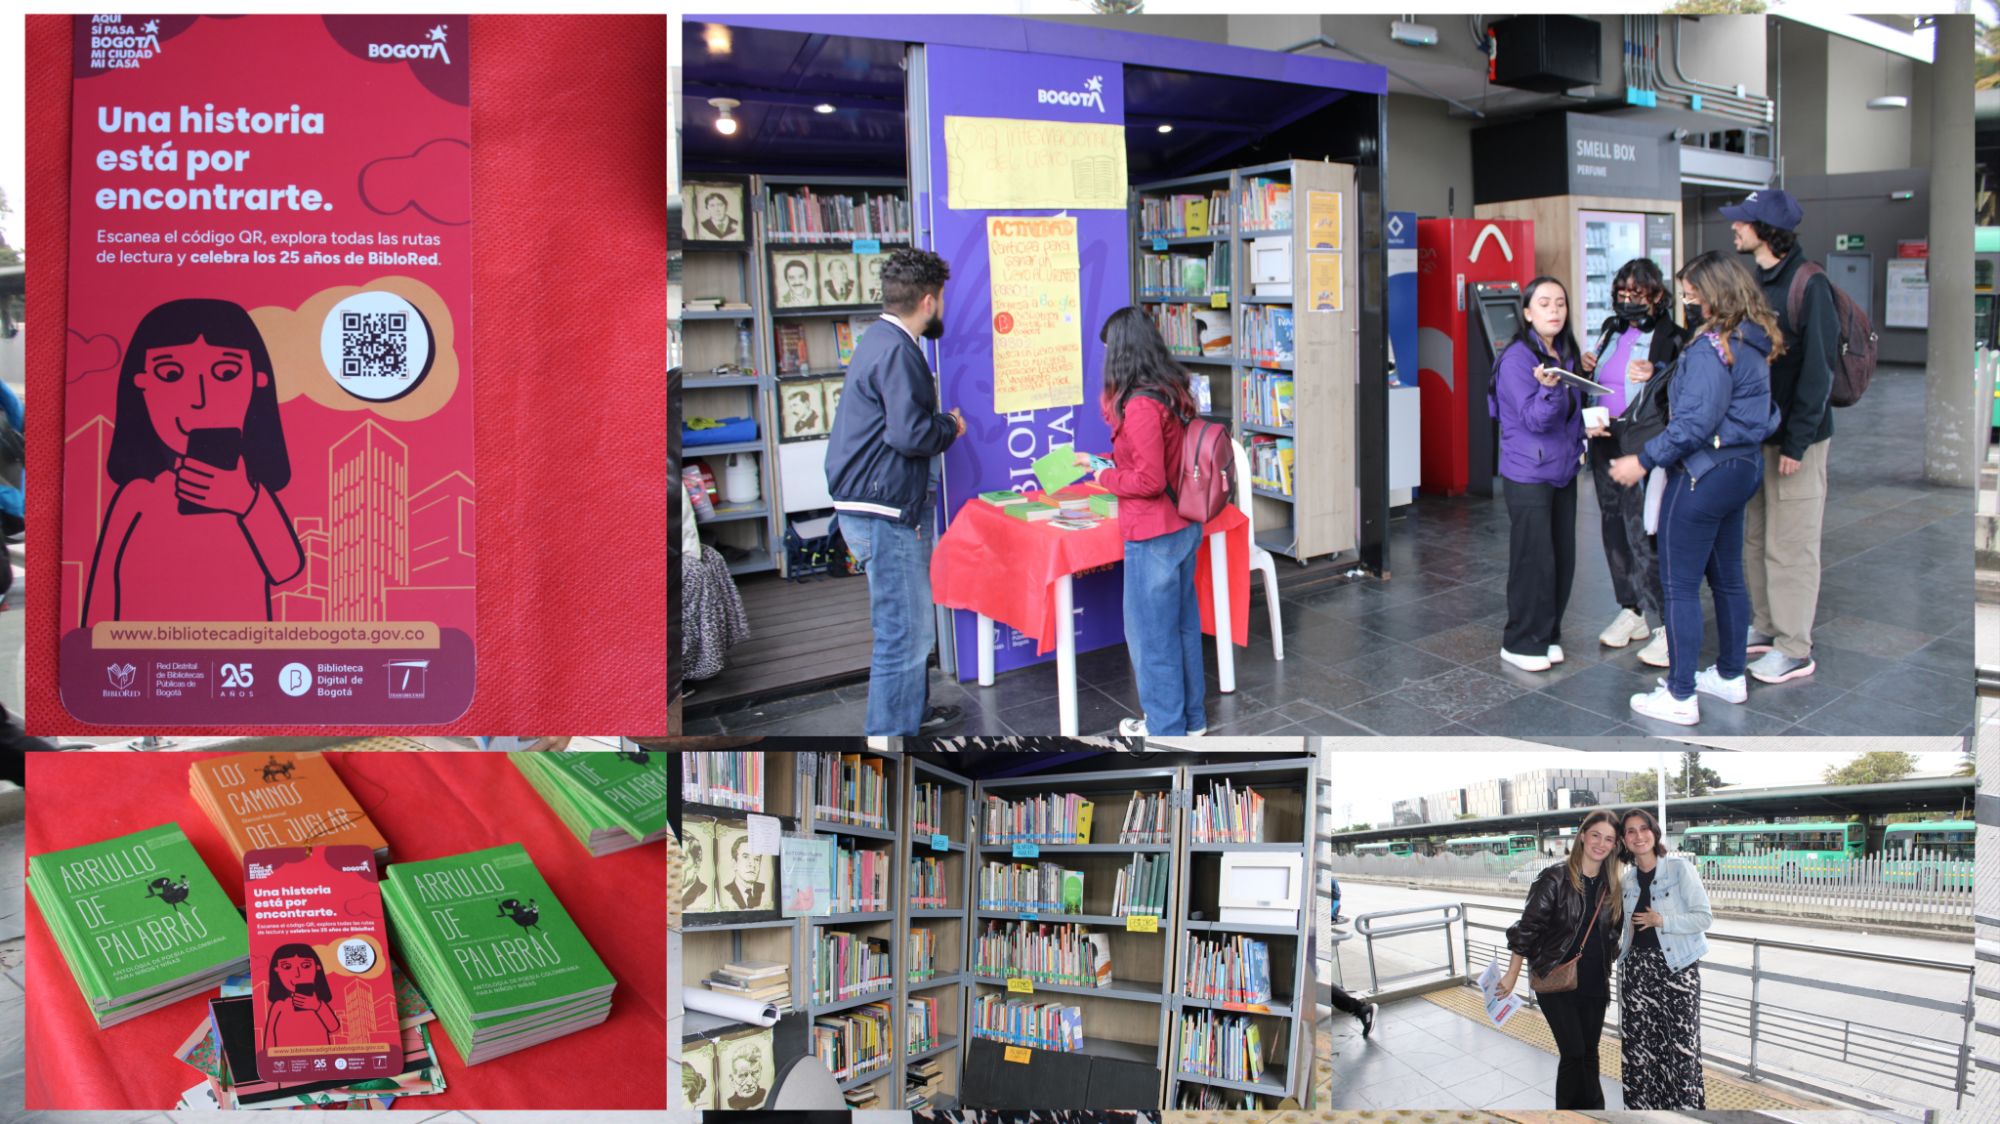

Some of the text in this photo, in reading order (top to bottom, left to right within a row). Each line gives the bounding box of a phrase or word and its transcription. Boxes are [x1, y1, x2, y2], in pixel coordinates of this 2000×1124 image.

[104, 25, 135, 35] PASA
[91, 49, 153, 59] MI CIUDAD
[91, 59, 140, 68] MI CASA
[97, 103, 324, 134] Una historia
[1576, 139, 1637, 161] SMELL BOX
[96, 141, 249, 181] está por
[1577, 164, 1608, 177] PERFUME
[95, 184, 333, 211] encontrarte.
[97, 230, 441, 247] Escanea el código QR, explora todas las rutas
[96, 249, 442, 266] de lectura y celebra los 25 años de BibloRed.
[110, 626, 425, 644] www.bibliotecadigitaldebogota.gov.co
[156, 662, 198, 670] Red Distrital
[317, 664, 364, 673] Biblioteca
[167, 671, 204, 679] Bibliotecas
[220, 663, 254, 688] 25
[317, 675, 363, 686] Digital de
[156, 679, 197, 689] Públicas de
[317, 687, 352, 698] Bogotá
[156, 689, 182, 698] Bogotá
[212, 763, 246, 788] LOS
[571, 760, 608, 786] DE
[227, 781, 304, 816] CAMINOS
[245, 808, 358, 850] DEL JUGLAR
[60, 845, 156, 893] ARRULLO
[253, 885, 331, 897] Una historia
[414, 863, 504, 903] ARRULLO
[75, 895, 114, 929] DE
[254, 897, 307, 910] está por
[255, 907, 337, 919] encontrarte.
[431, 908, 470, 941] DE
[96, 906, 208, 968] PALABRAS
[454, 932, 561, 981] PALABRAS
